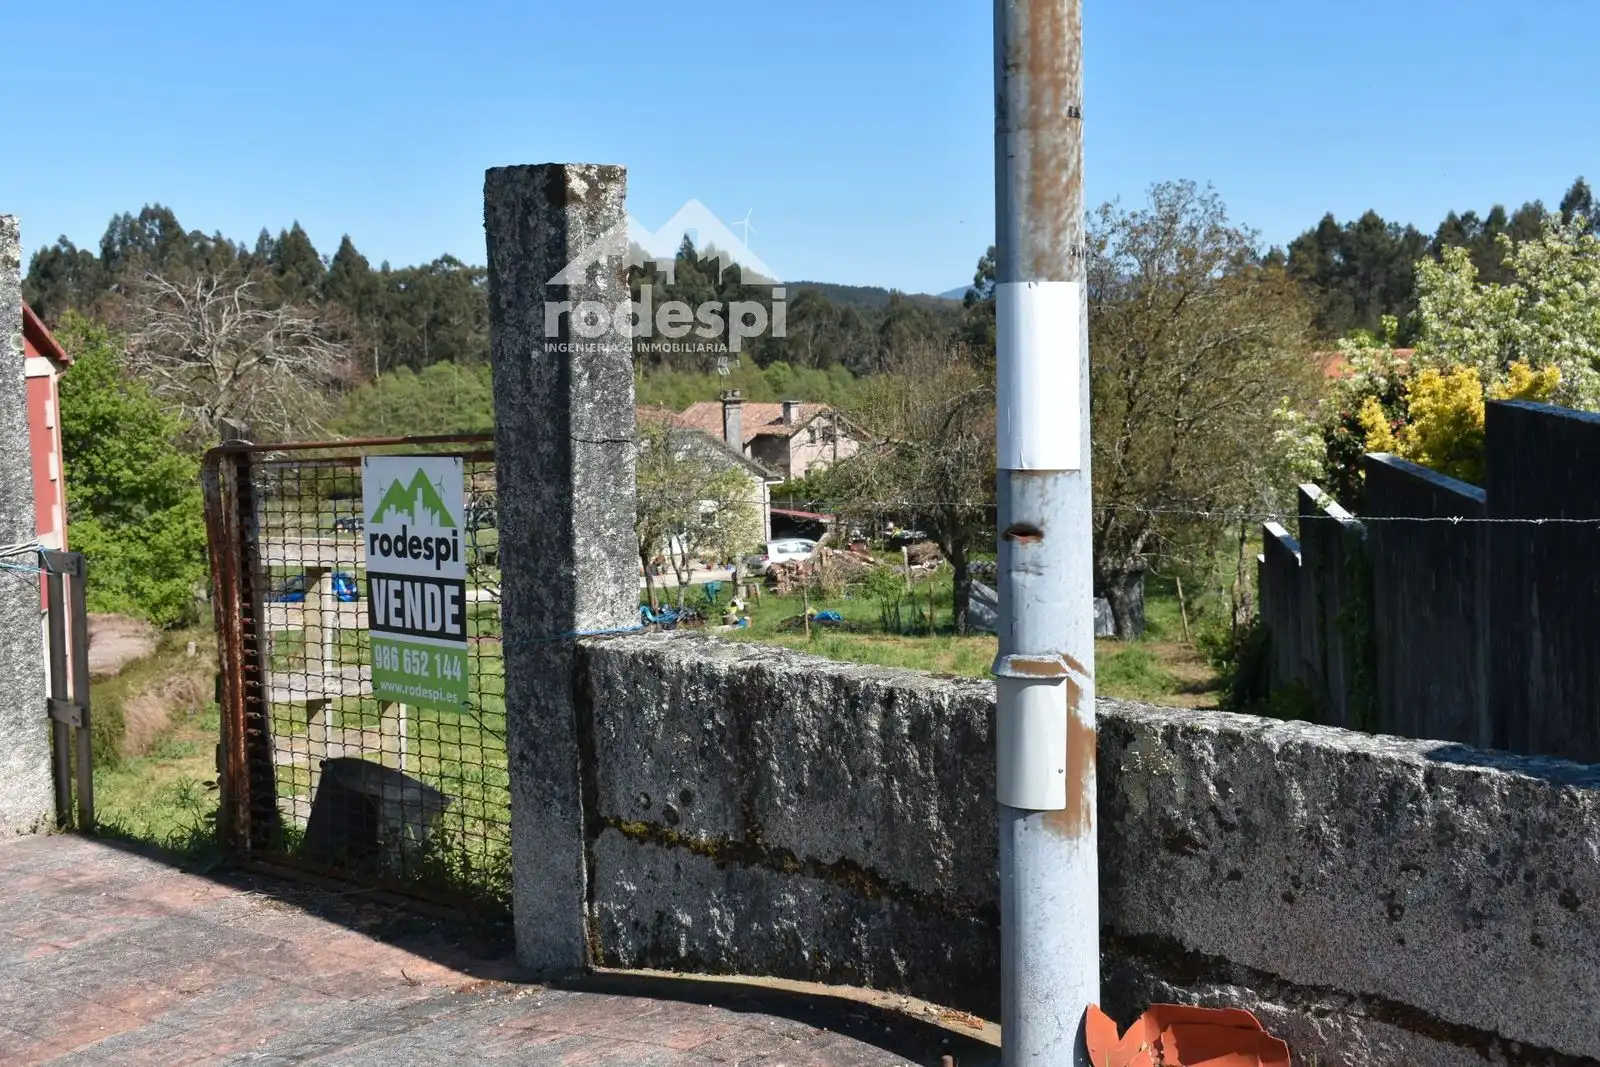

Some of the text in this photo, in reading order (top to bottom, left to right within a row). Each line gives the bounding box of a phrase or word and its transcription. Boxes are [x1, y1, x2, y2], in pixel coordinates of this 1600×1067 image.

[369, 524, 459, 571] rodespi
[371, 577, 461, 635] VENDE
[374, 643, 462, 682] 986 652 144
[380, 680, 458, 704] www.rodespi.es
